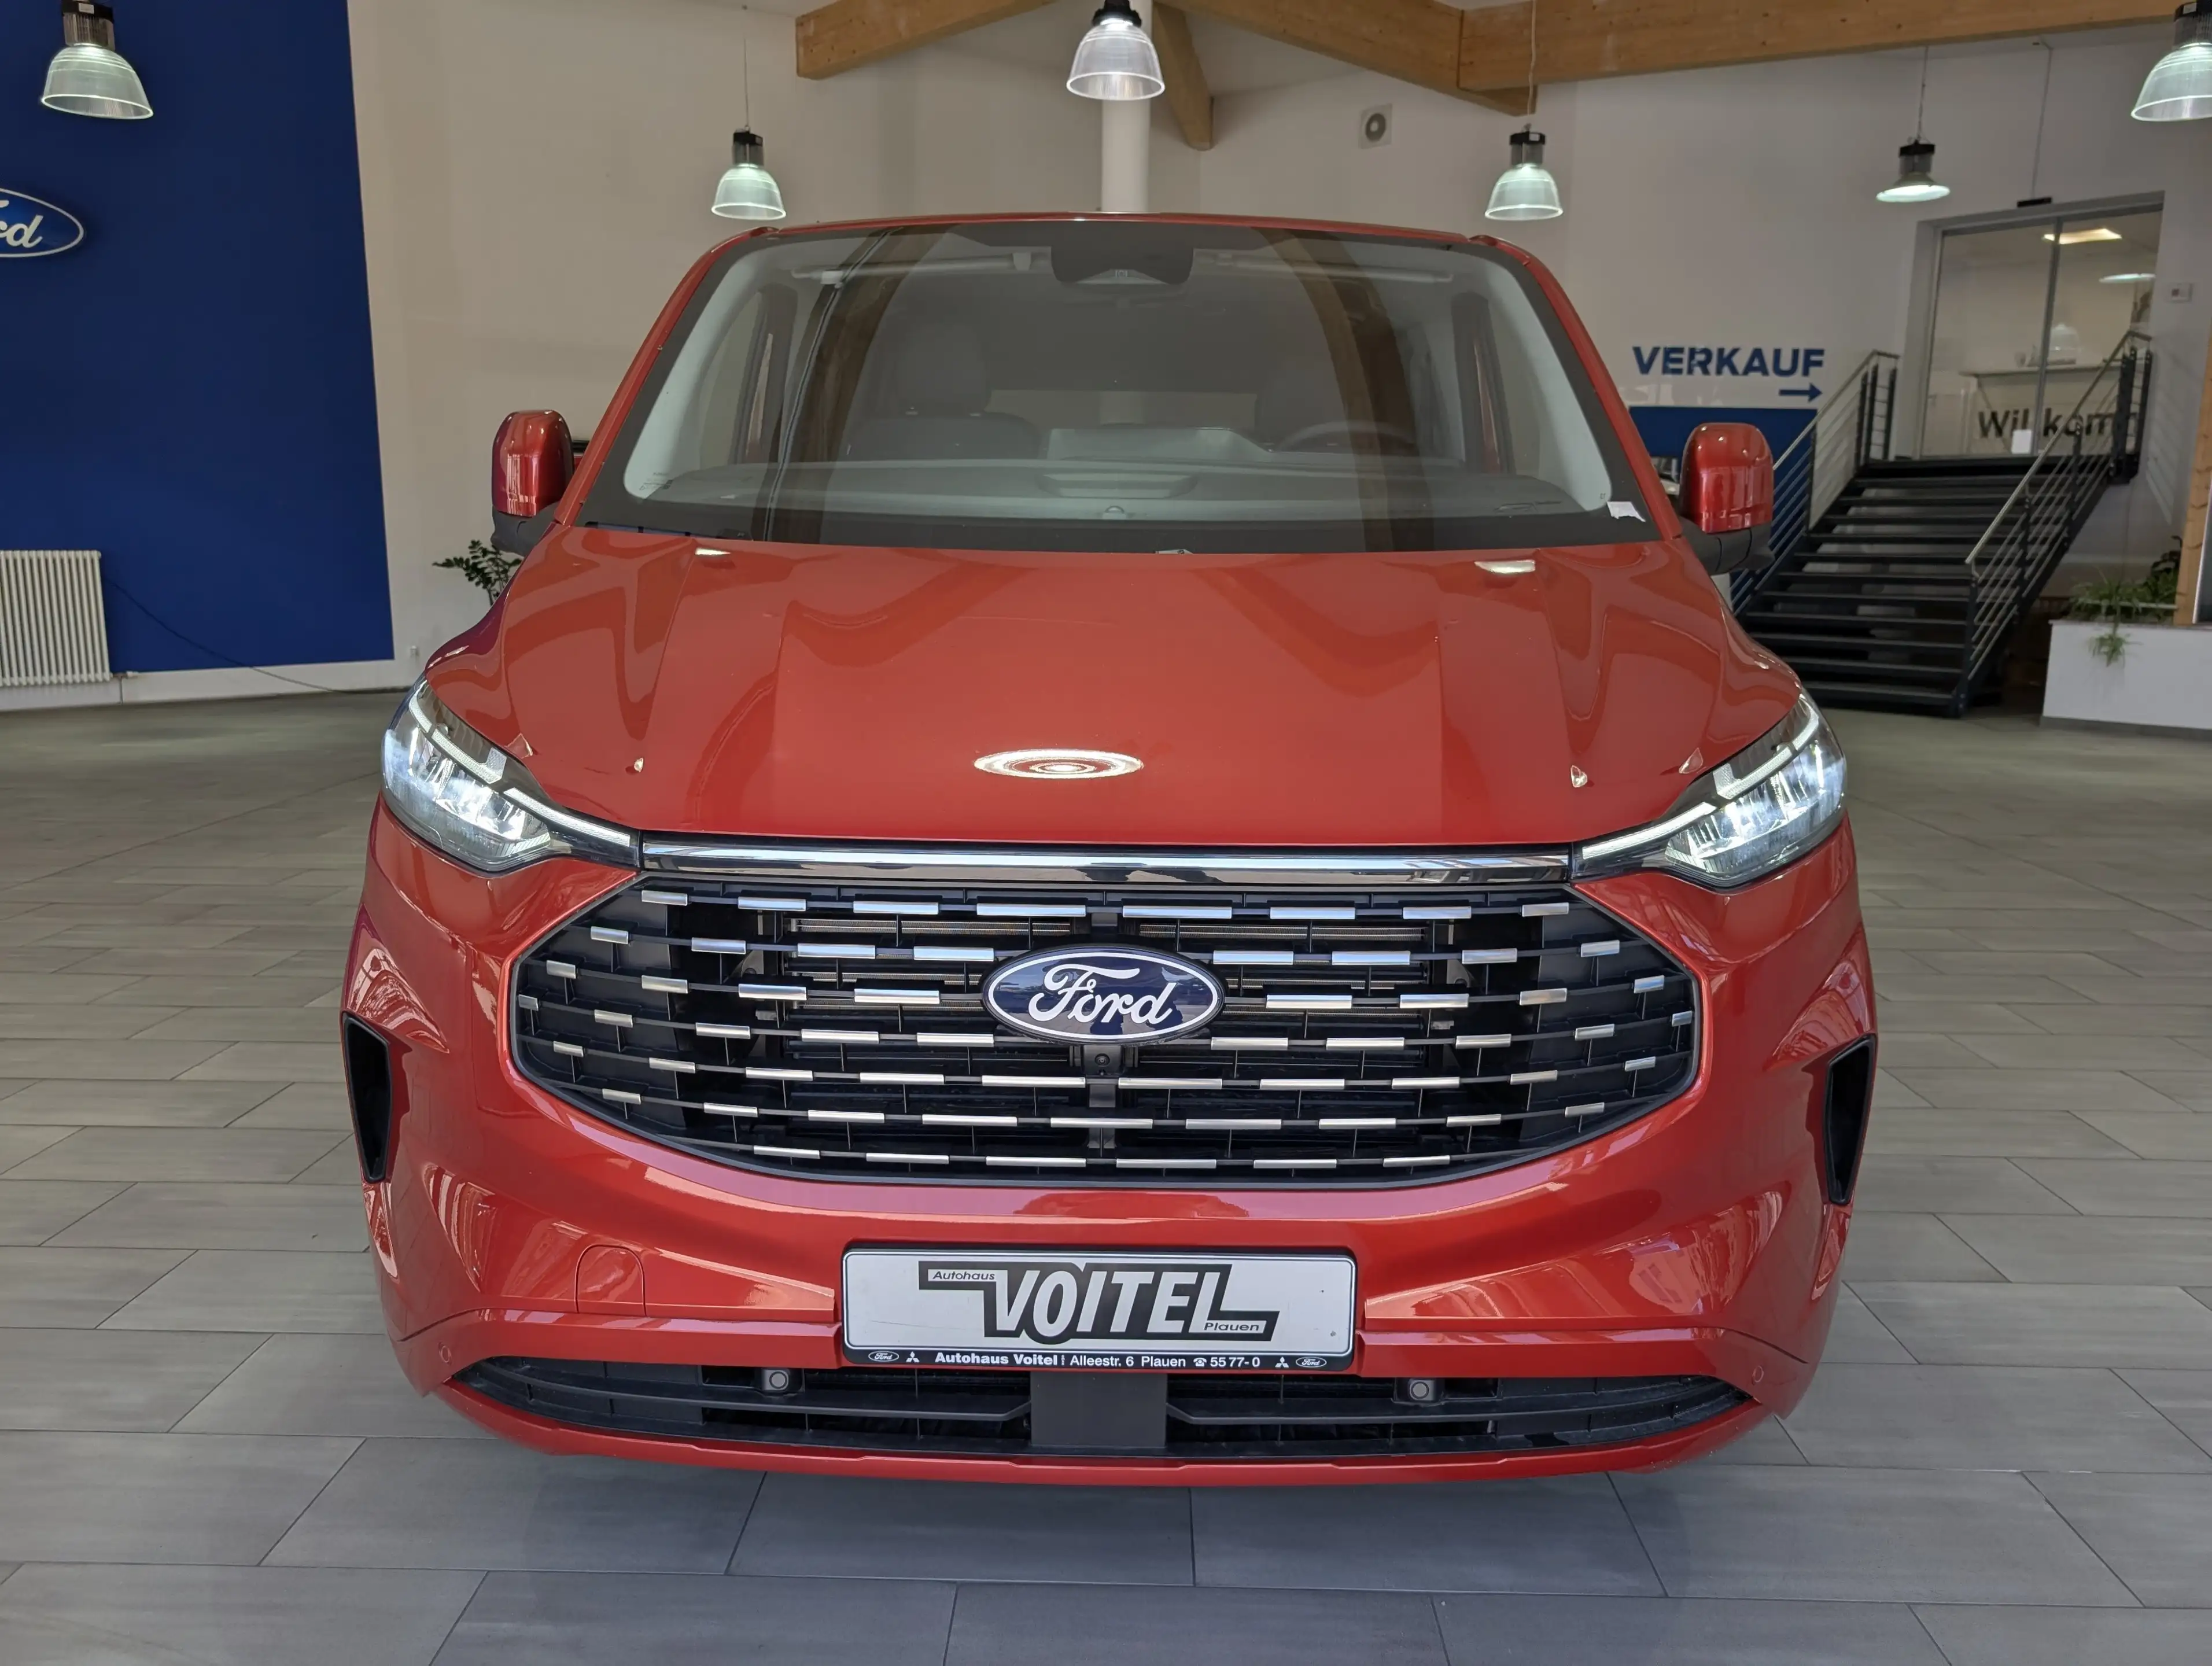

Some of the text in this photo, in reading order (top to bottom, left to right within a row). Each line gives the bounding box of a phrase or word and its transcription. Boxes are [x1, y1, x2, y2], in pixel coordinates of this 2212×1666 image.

[1632, 346, 1825, 377] VERKAUF
[1028, 963, 1178, 1024] Ford
[932, 1271, 995, 1280] Autohaus
[996, 1269, 1266, 1337] VOITEL
[1203, 1322, 1259, 1331] Plauen
[935, 1352, 1009, 1364] Autohaus
[1013, 1354, 1058, 1366] Voitel
[1070, 1355, 1122, 1368] Alleestr.
[1126, 1356, 1134, 1367] 6
[1141, 1355, 1186, 1368] Plauen
